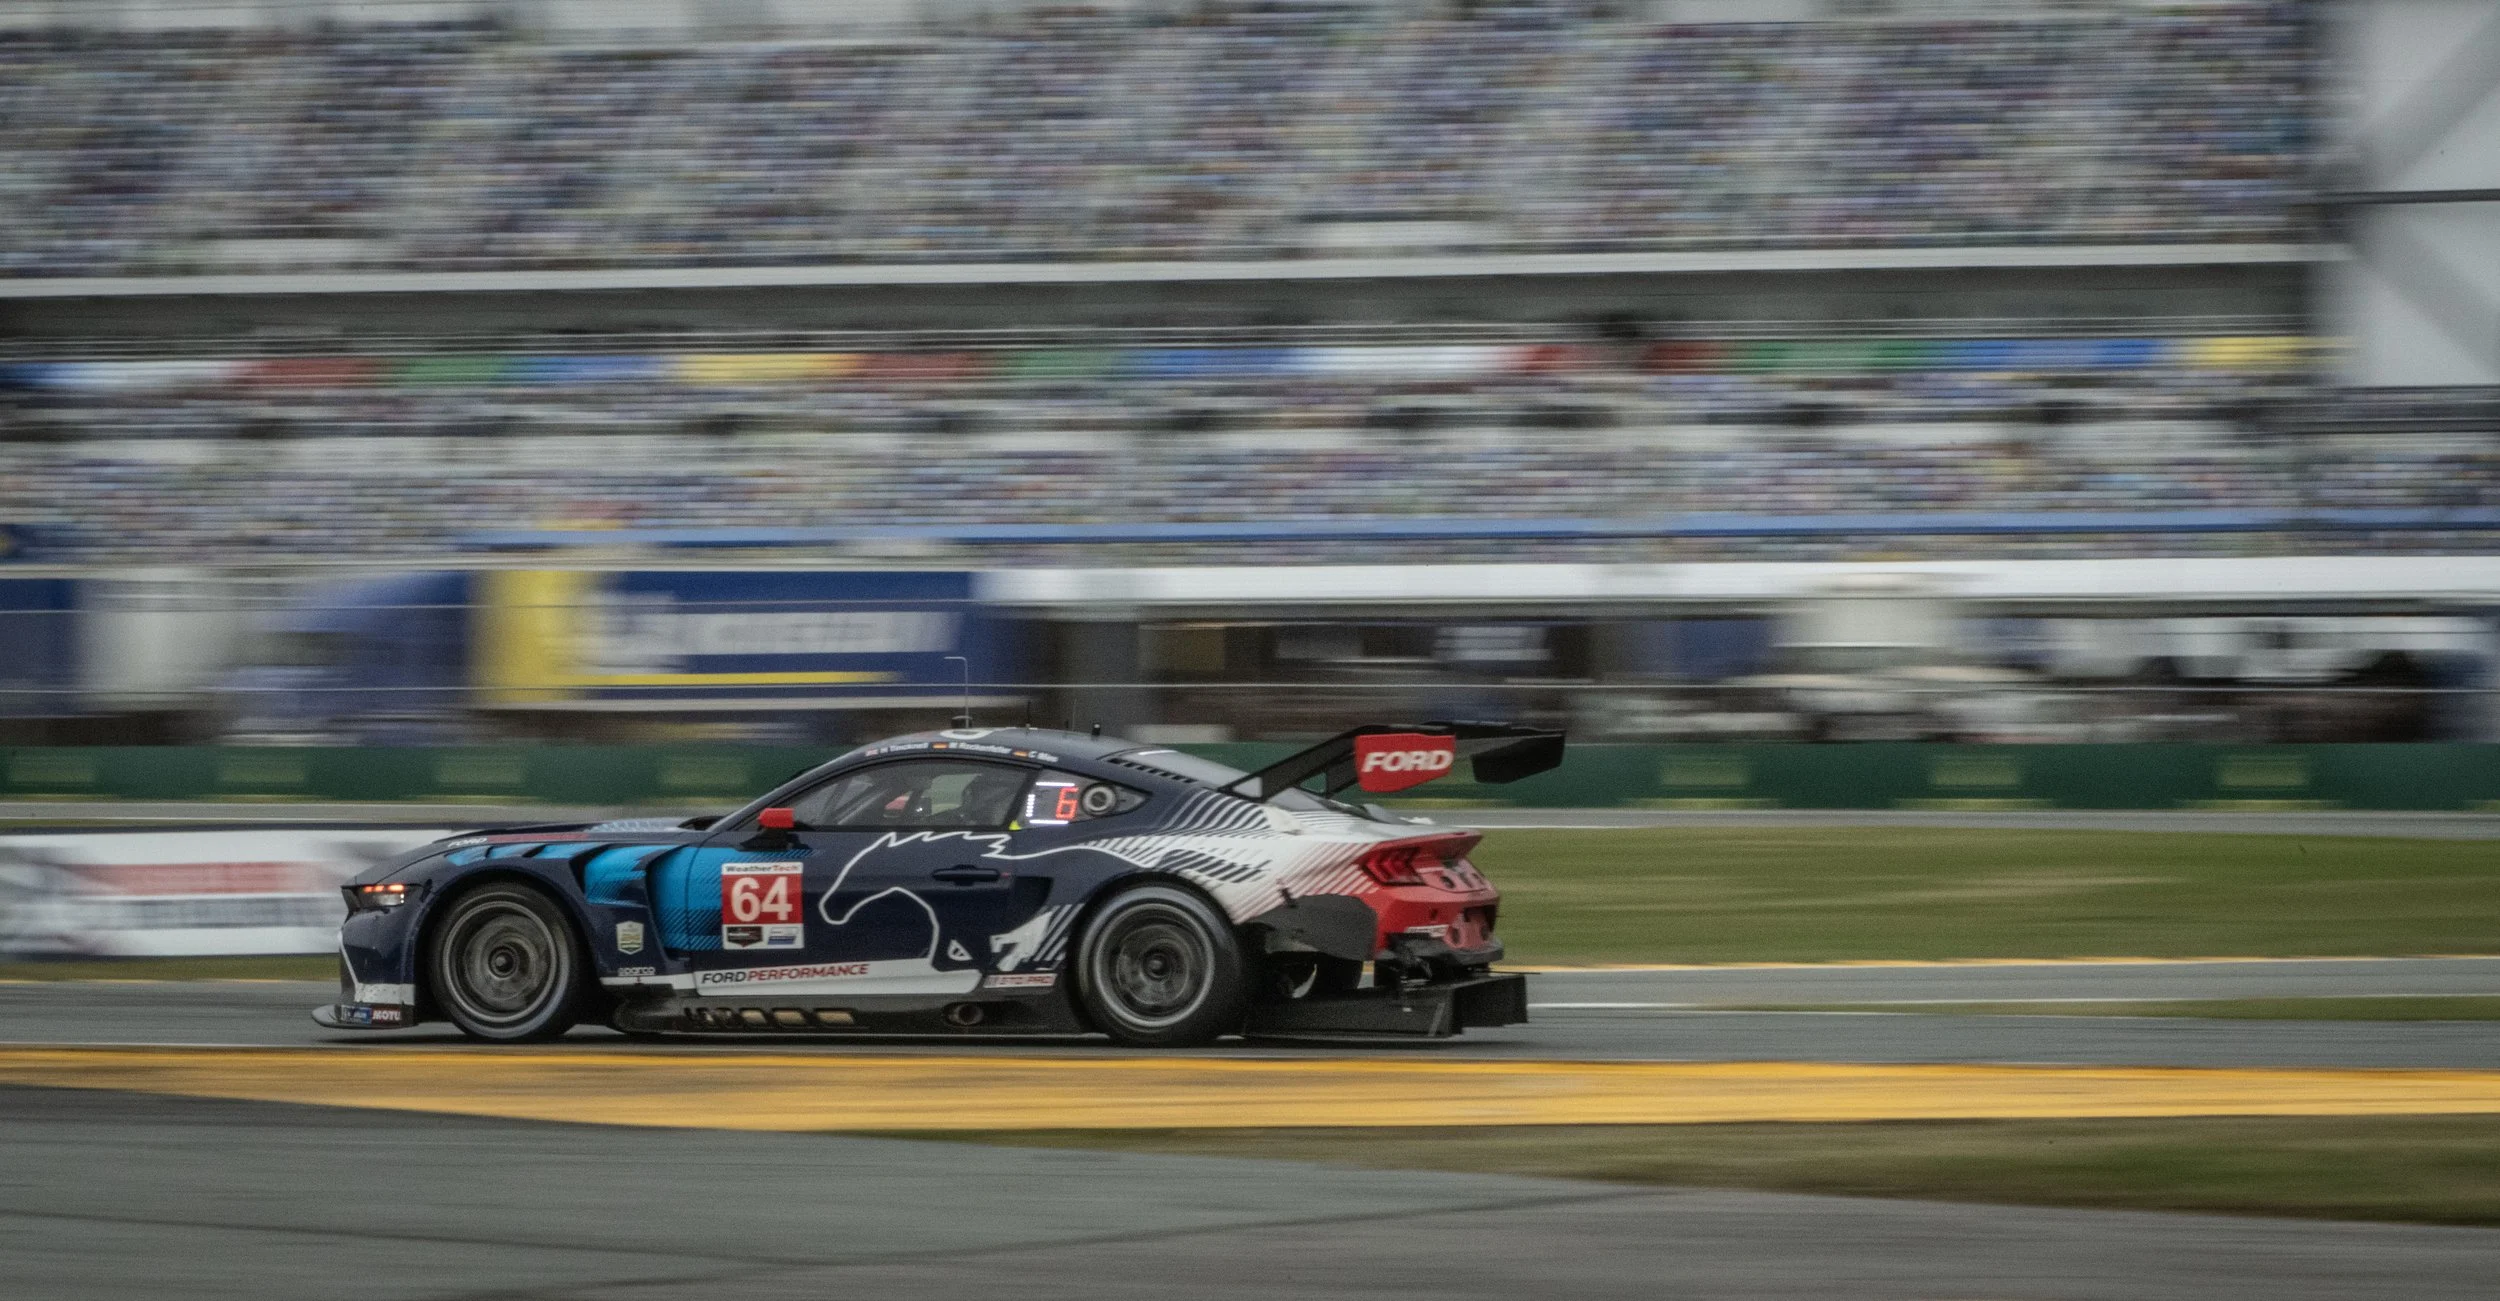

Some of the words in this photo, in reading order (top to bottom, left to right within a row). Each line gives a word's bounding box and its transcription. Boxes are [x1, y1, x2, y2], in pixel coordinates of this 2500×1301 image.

[1361, 750, 1454, 773] FORD
[1055, 787, 1079, 820] 6
[726, 865, 799, 873] WeatherTech
[731, 876, 793, 922] 64
